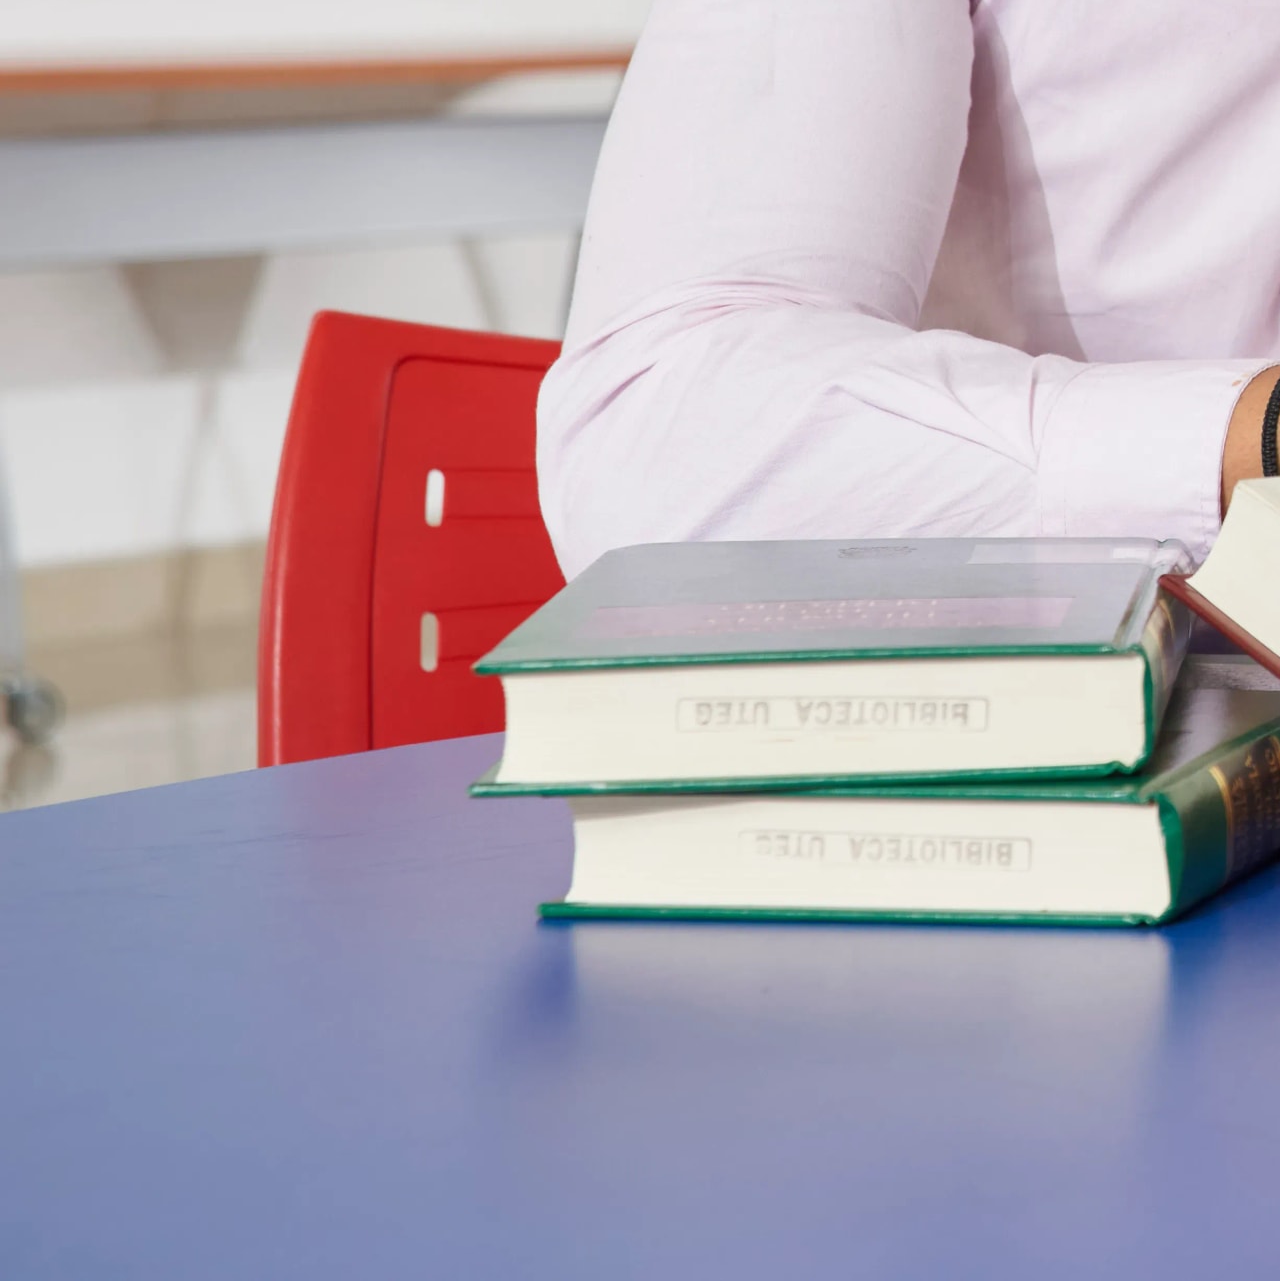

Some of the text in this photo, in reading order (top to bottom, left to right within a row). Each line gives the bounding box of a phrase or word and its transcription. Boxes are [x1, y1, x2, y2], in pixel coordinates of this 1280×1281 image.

[694, 700, 969, 727] BIBLIOTECA UTEG
[849, 836, 1013, 867] BIBLIOTECA
